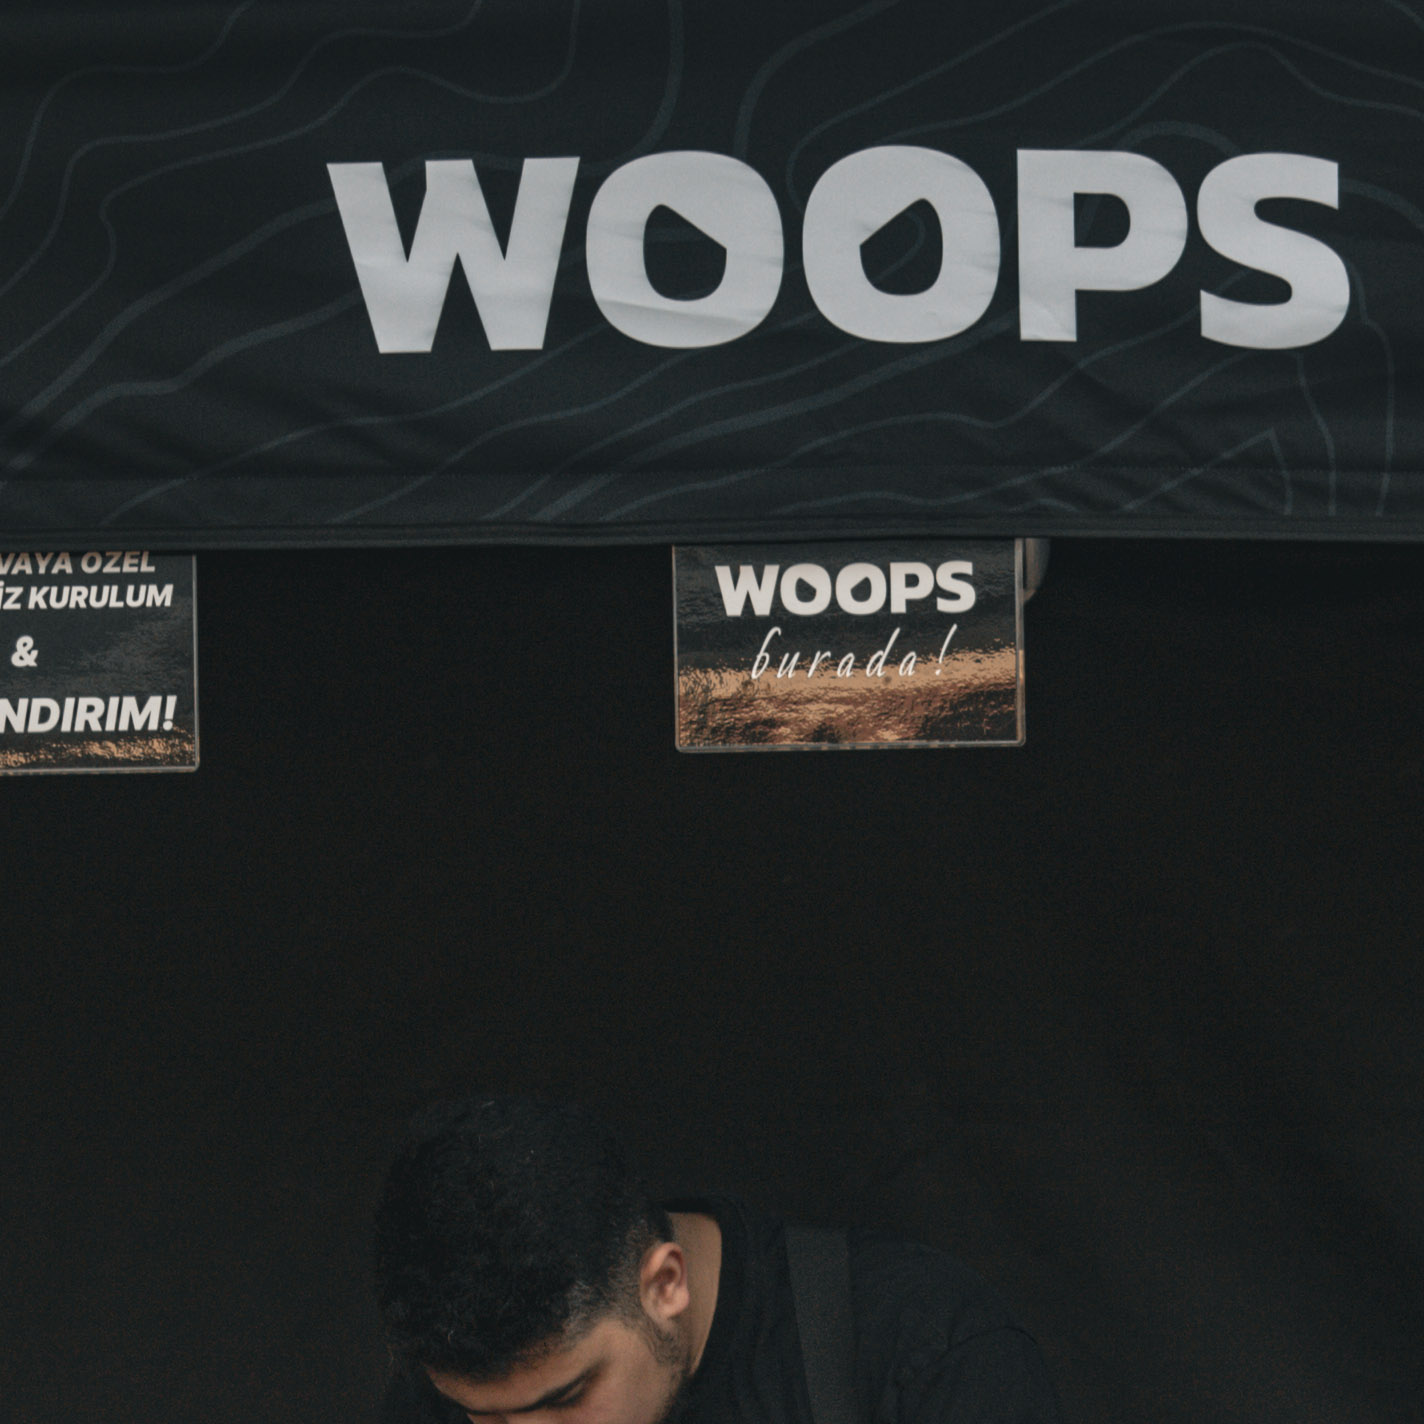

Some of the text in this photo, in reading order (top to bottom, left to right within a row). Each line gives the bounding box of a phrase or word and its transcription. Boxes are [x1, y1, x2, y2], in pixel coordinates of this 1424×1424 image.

[327, 145, 1352, 354] WOOPS
[27, 584, 174, 610] KURULUM
[714, 560, 976, 617] WOOPS
[10, 635, 38, 667] &
